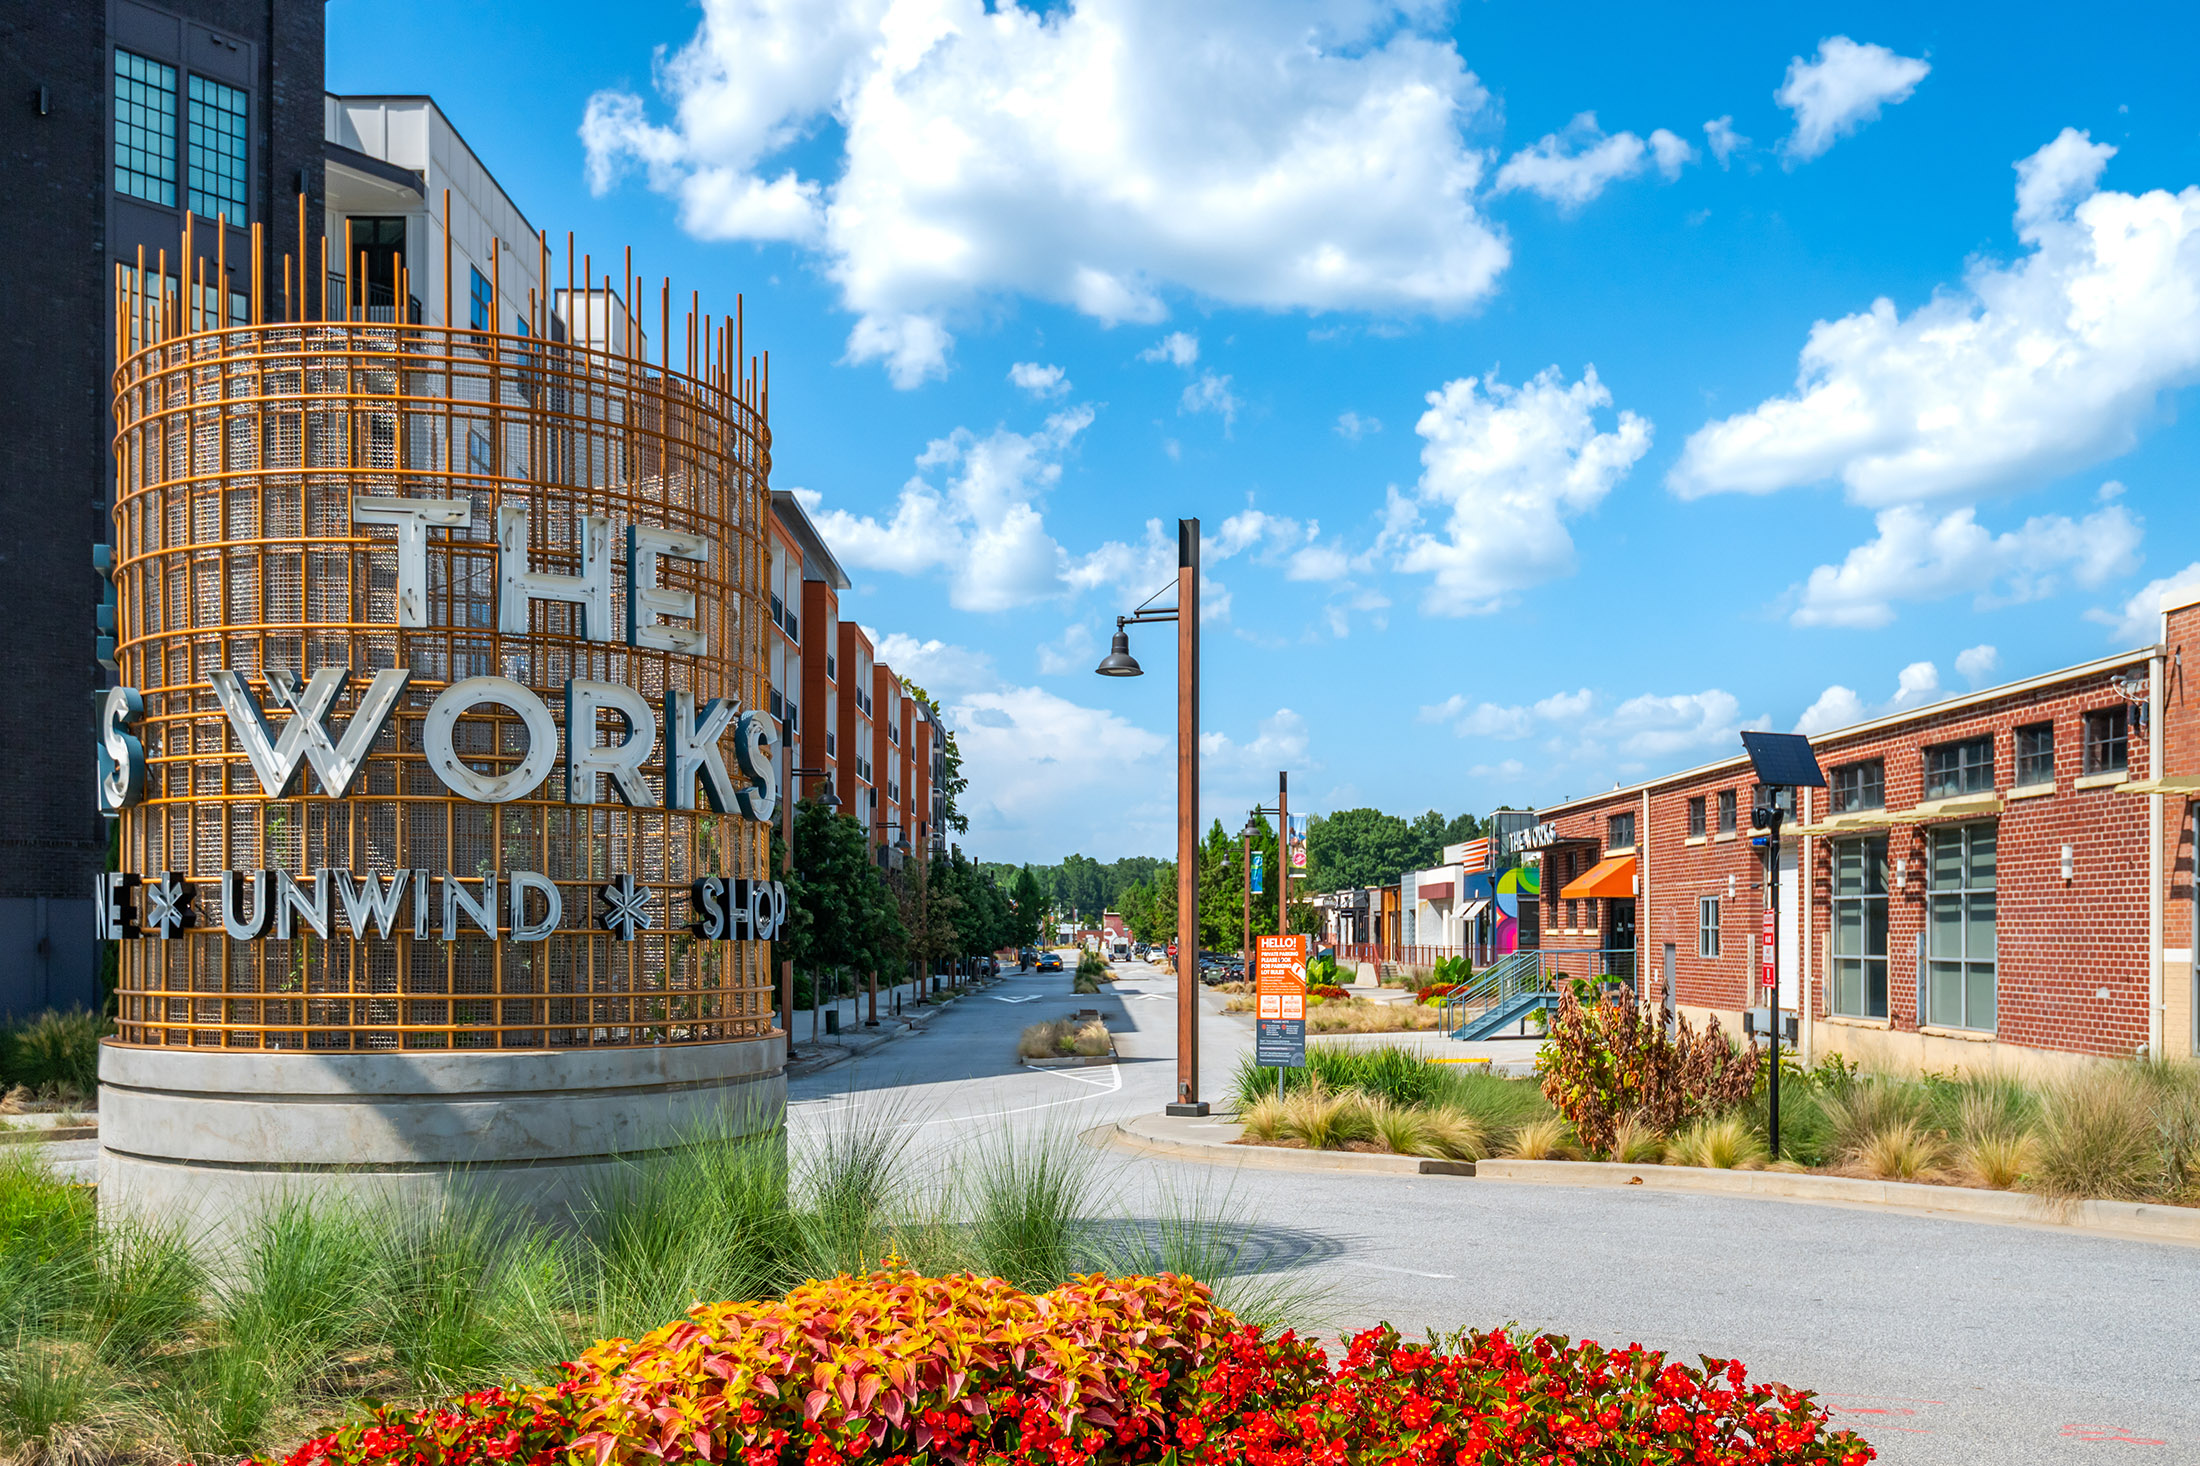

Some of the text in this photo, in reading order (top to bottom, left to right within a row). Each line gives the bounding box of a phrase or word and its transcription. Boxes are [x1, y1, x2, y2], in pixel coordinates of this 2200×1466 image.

[353, 495, 708, 656] THE
[207, 667, 777, 822] WORKS
[1509, 822, 1556, 853] THE WORKS
[222, 869, 562, 941] UNWIND
[702, 876, 787, 941] SHOP
[1261, 937, 1297, 948] HELLO!
